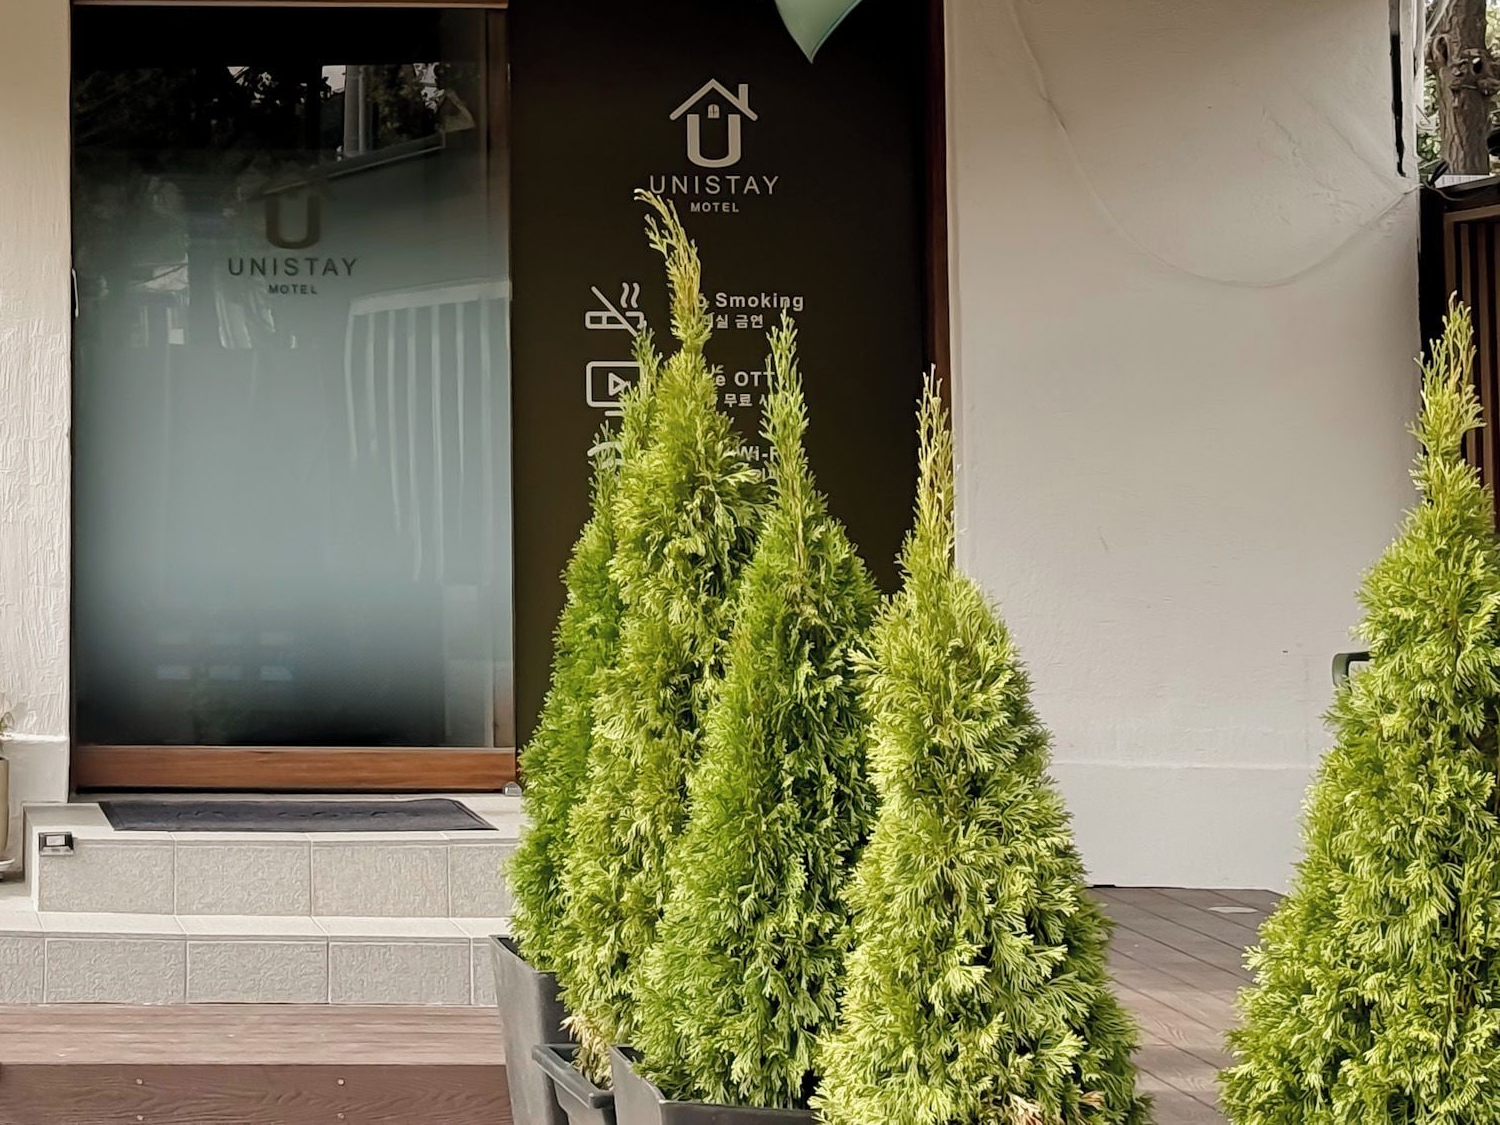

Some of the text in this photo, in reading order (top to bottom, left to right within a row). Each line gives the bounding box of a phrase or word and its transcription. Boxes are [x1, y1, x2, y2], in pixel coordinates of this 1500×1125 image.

[650, 175, 779, 194] UNISTAY
[690, 202, 739, 213] MOTEL
[228, 257, 358, 276] UNISTAY
[268, 284, 318, 295] MOTEL
[715, 292, 804, 311] Smoking
[735, 314, 764, 329] 금연
[723, 393, 753, 408] 무료
